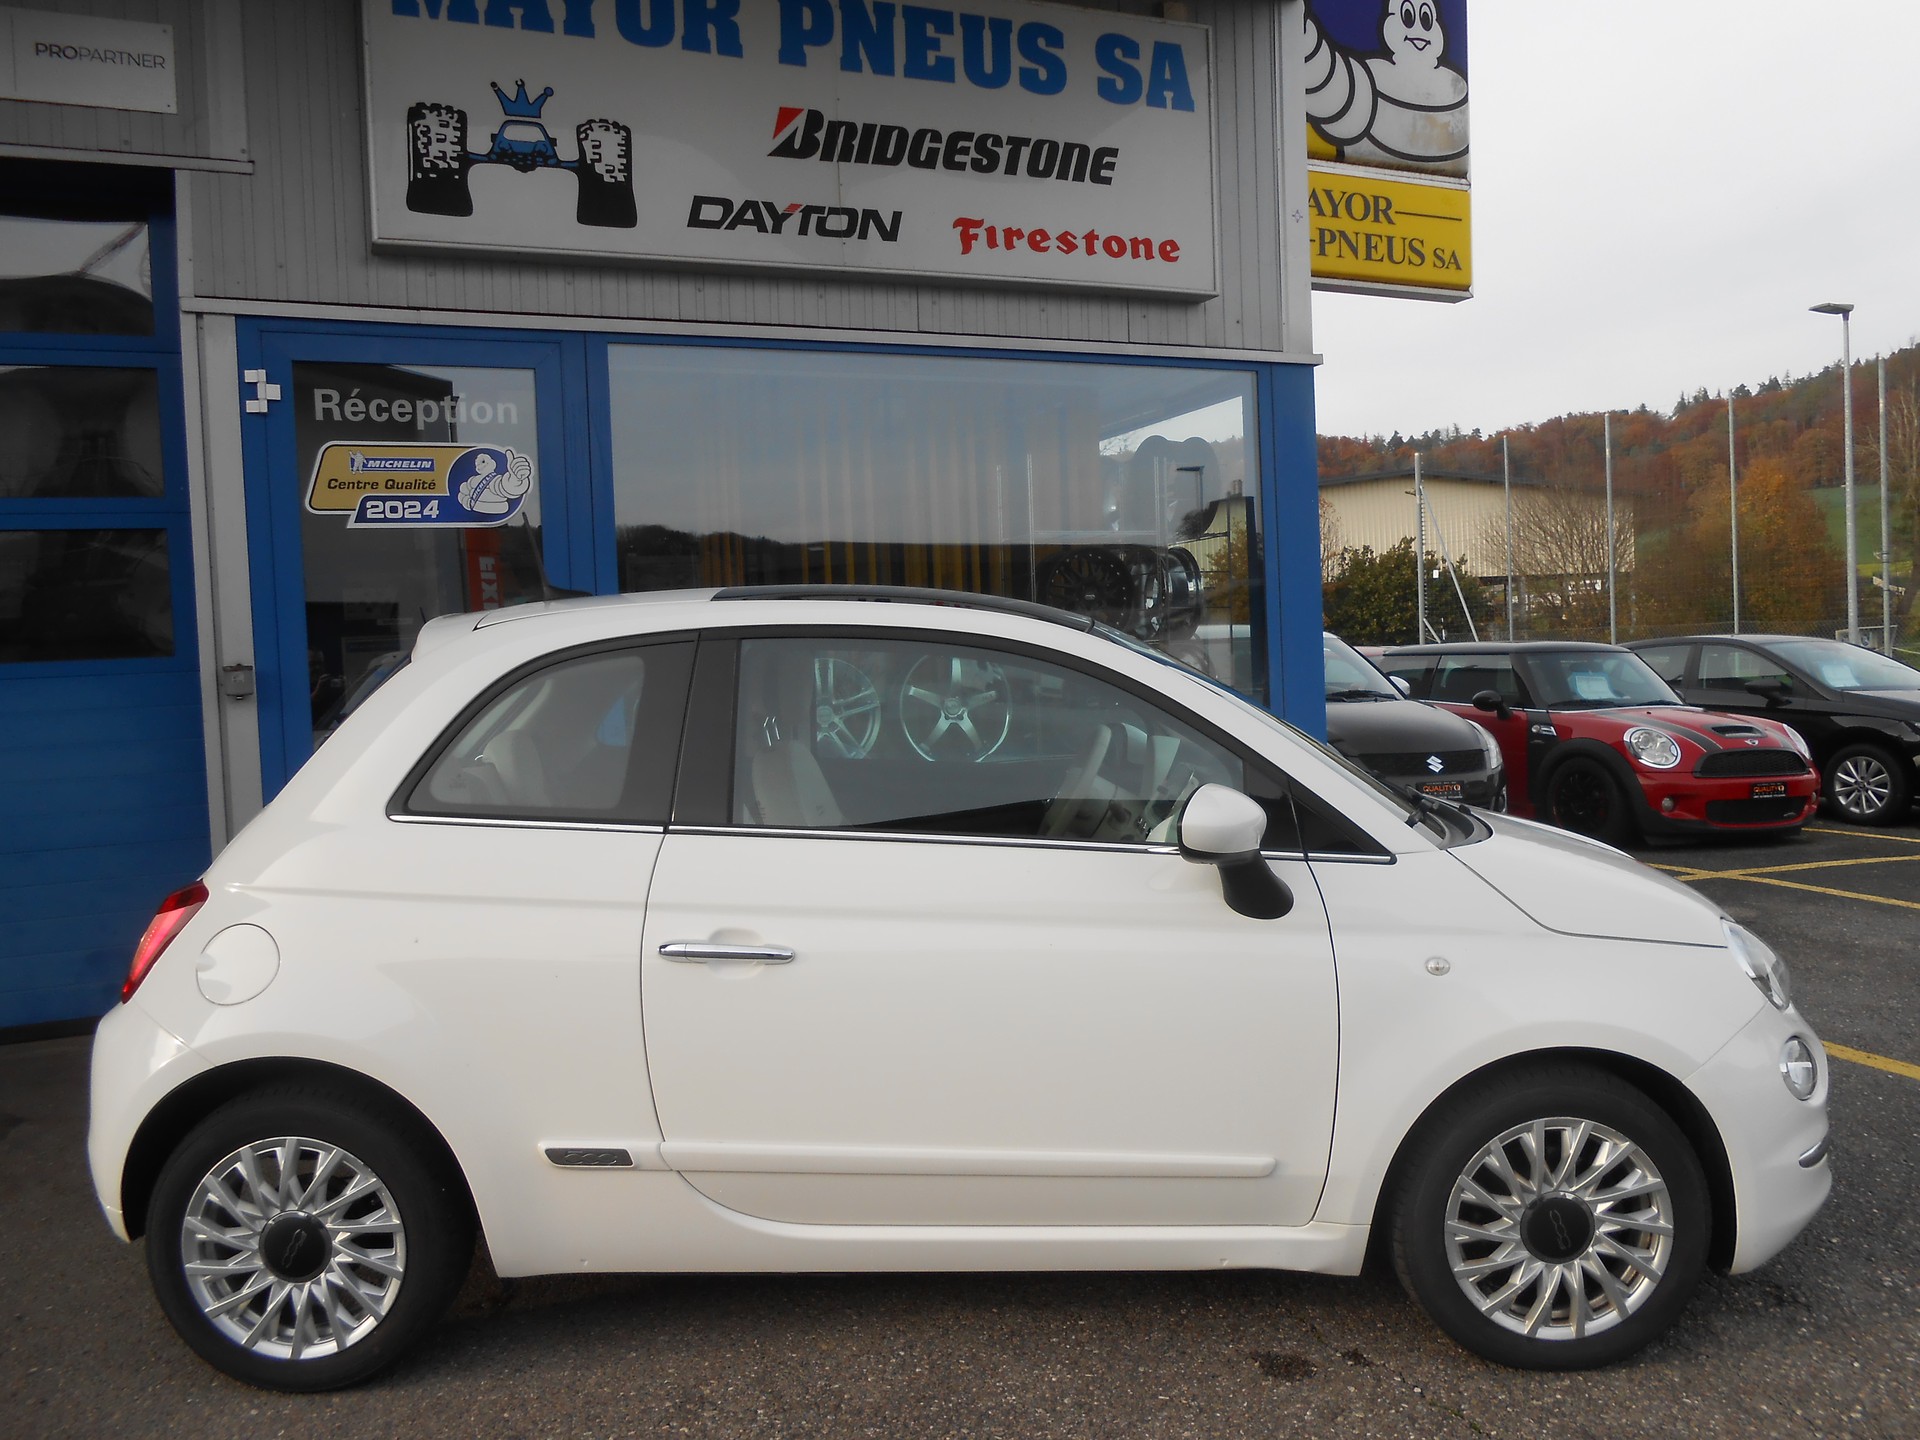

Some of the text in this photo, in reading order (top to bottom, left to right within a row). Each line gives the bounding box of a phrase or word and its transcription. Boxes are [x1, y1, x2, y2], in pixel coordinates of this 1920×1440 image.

[35, 42, 166, 69] PROPARTNER
[778, 0, 1067, 96] PNEUS
[1095, 33, 1196, 113] SA
[767, 106, 1119, 186] BRIDGESTONE
[687, 195, 902, 242] DAYTON
[952, 216, 1181, 263] Firestone
[1433, 247, 1463, 271] SA
[313, 387, 519, 431] Réception
[367, 459, 432, 469] MICHELIN
[327, 478, 437, 490] Centre Qualité
[366, 500, 440, 519] 2024
